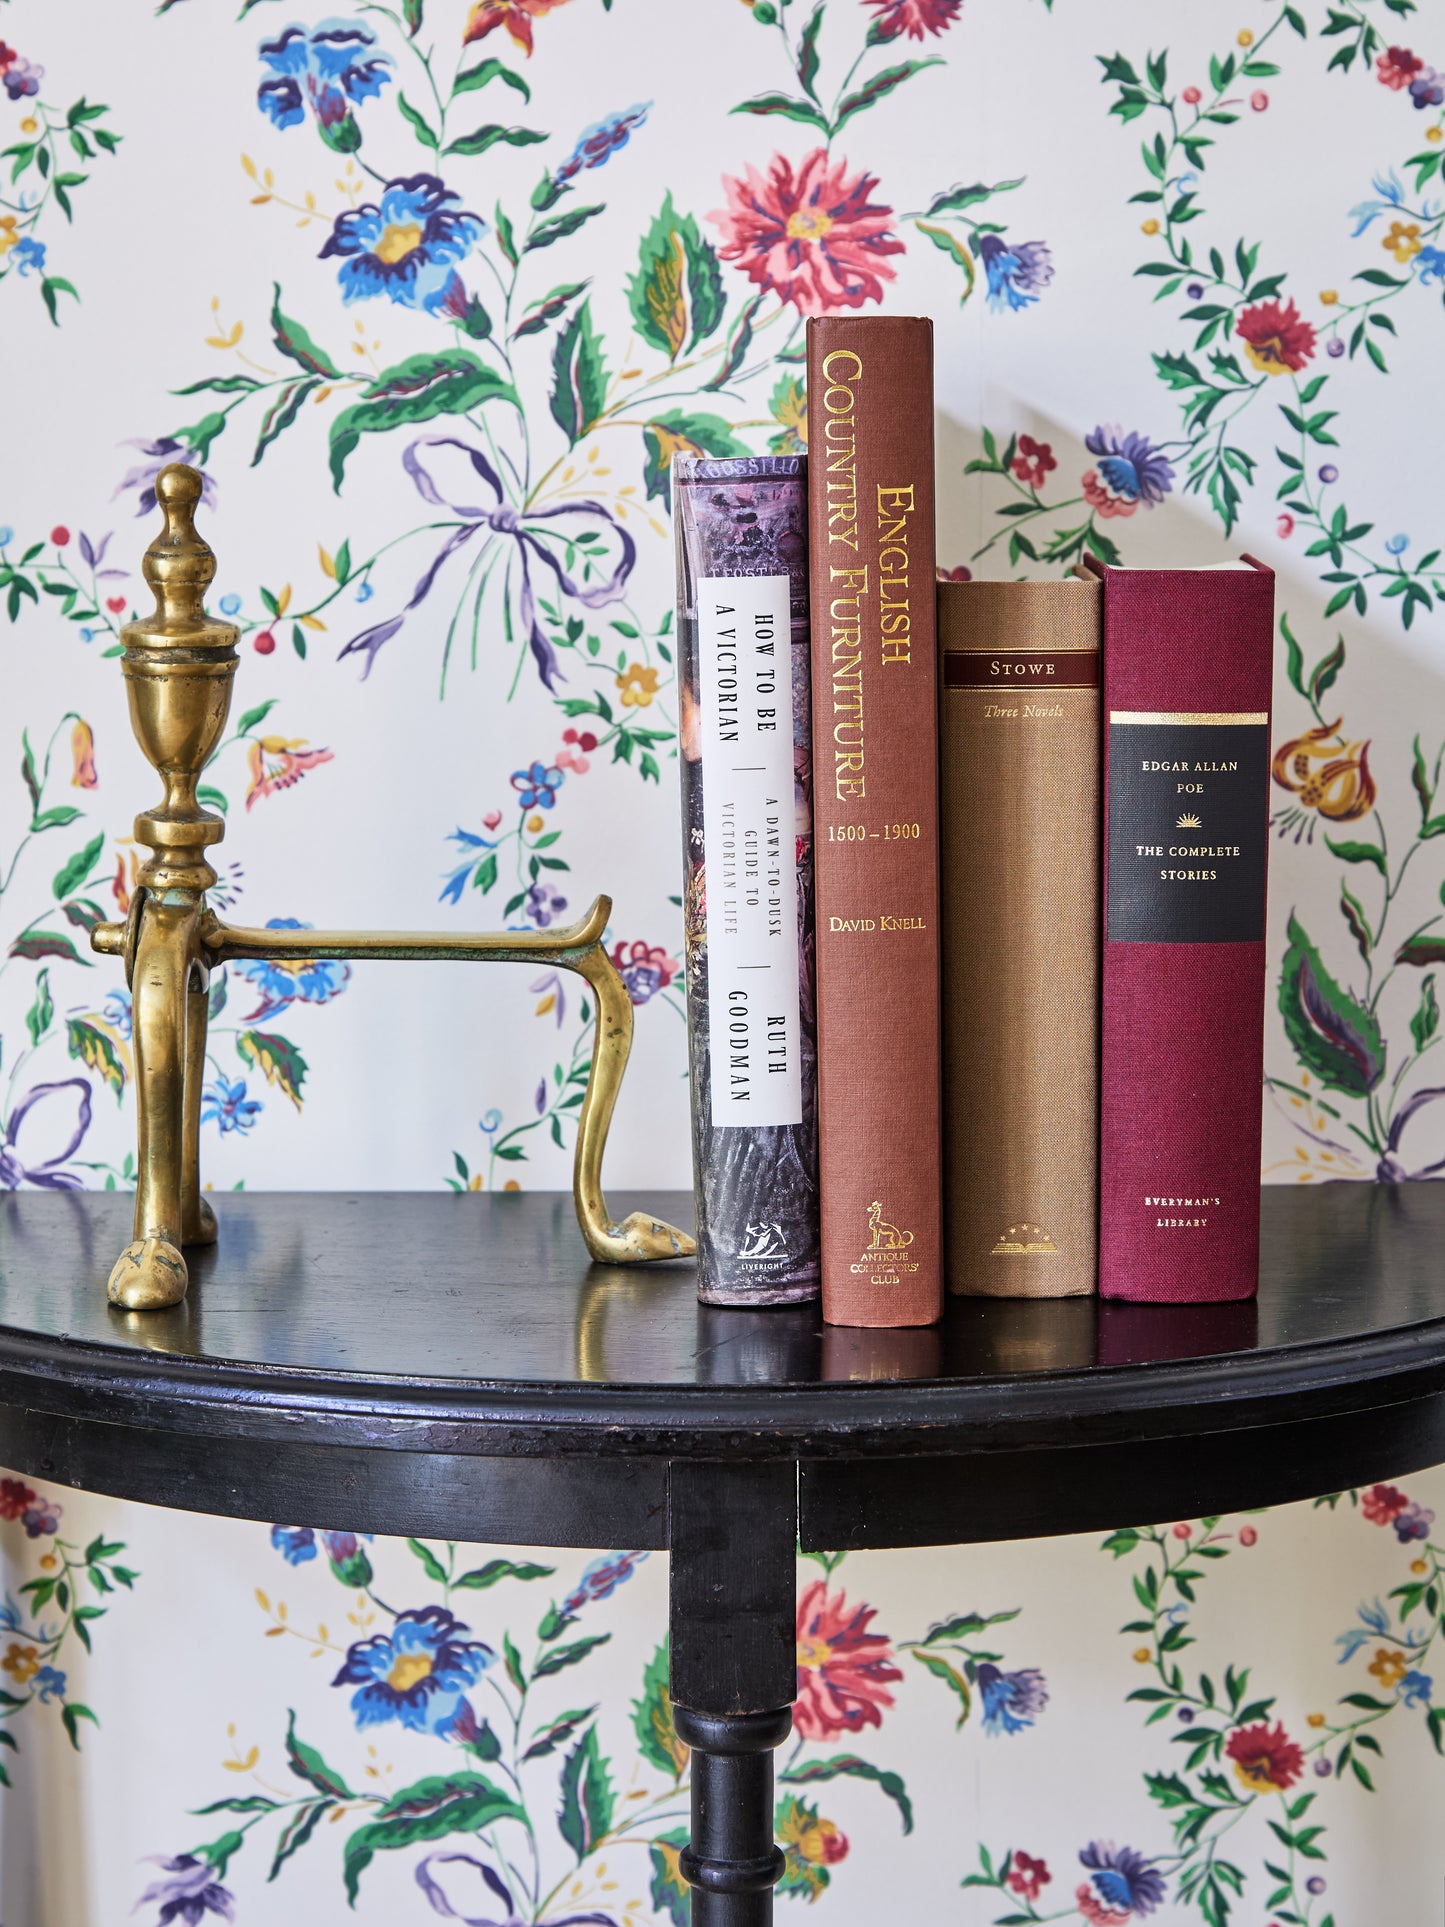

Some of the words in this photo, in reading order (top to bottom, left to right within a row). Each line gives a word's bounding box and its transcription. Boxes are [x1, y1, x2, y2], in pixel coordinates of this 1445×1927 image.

[822, 349, 863, 552] COUNTRY
[876, 483, 915, 666] ENGLISH
[716, 604, 736, 616] A
[754, 614, 775, 657] HOW
[990, 660, 1056, 676] STOWE
[716, 628, 739, 742] VICTORIAN
[756, 669, 776, 694] TO
[829, 564, 868, 802] FURNITURE
[757, 707, 777, 731] BE
[984, 704, 1019, 718] Three
[1022, 704, 1064, 718] Novels
[1142, 760, 1190, 772] EDGAR
[1193, 760, 1239, 772] ALLAN
[1176, 782, 1204, 794] POE
[765, 798, 778, 806] A
[722, 803, 737, 888] VICTORIAN
[744, 830, 759, 877] GUIDE
[1136, 845, 1164, 857] THE
[1168, 845, 1241, 857] COMPLETE
[766, 817, 782, 936] DAWN-TO-DUSK
[1160, 869, 1217, 881] STORIES
[746, 888, 759, 906] TO
[724, 900, 738, 934] LIFE
[829, 917, 876, 932] DAVID
[880, 916, 926, 931] KNELL
[728, 990, 750, 1101] GOODMAN
[767, 1015, 787, 1074] RUTH
[1144, 1196, 1220, 1207] EVERYMAN'S
[1157, 1217, 1208, 1227] LIBRARY
[860, 1252, 909, 1263] ANTIQUE
[741, 1262, 784, 1271] LIVERIGHT
[850, 1262, 920, 1274] COLLECTORS'
[871, 1275, 900, 1285] CLUB
